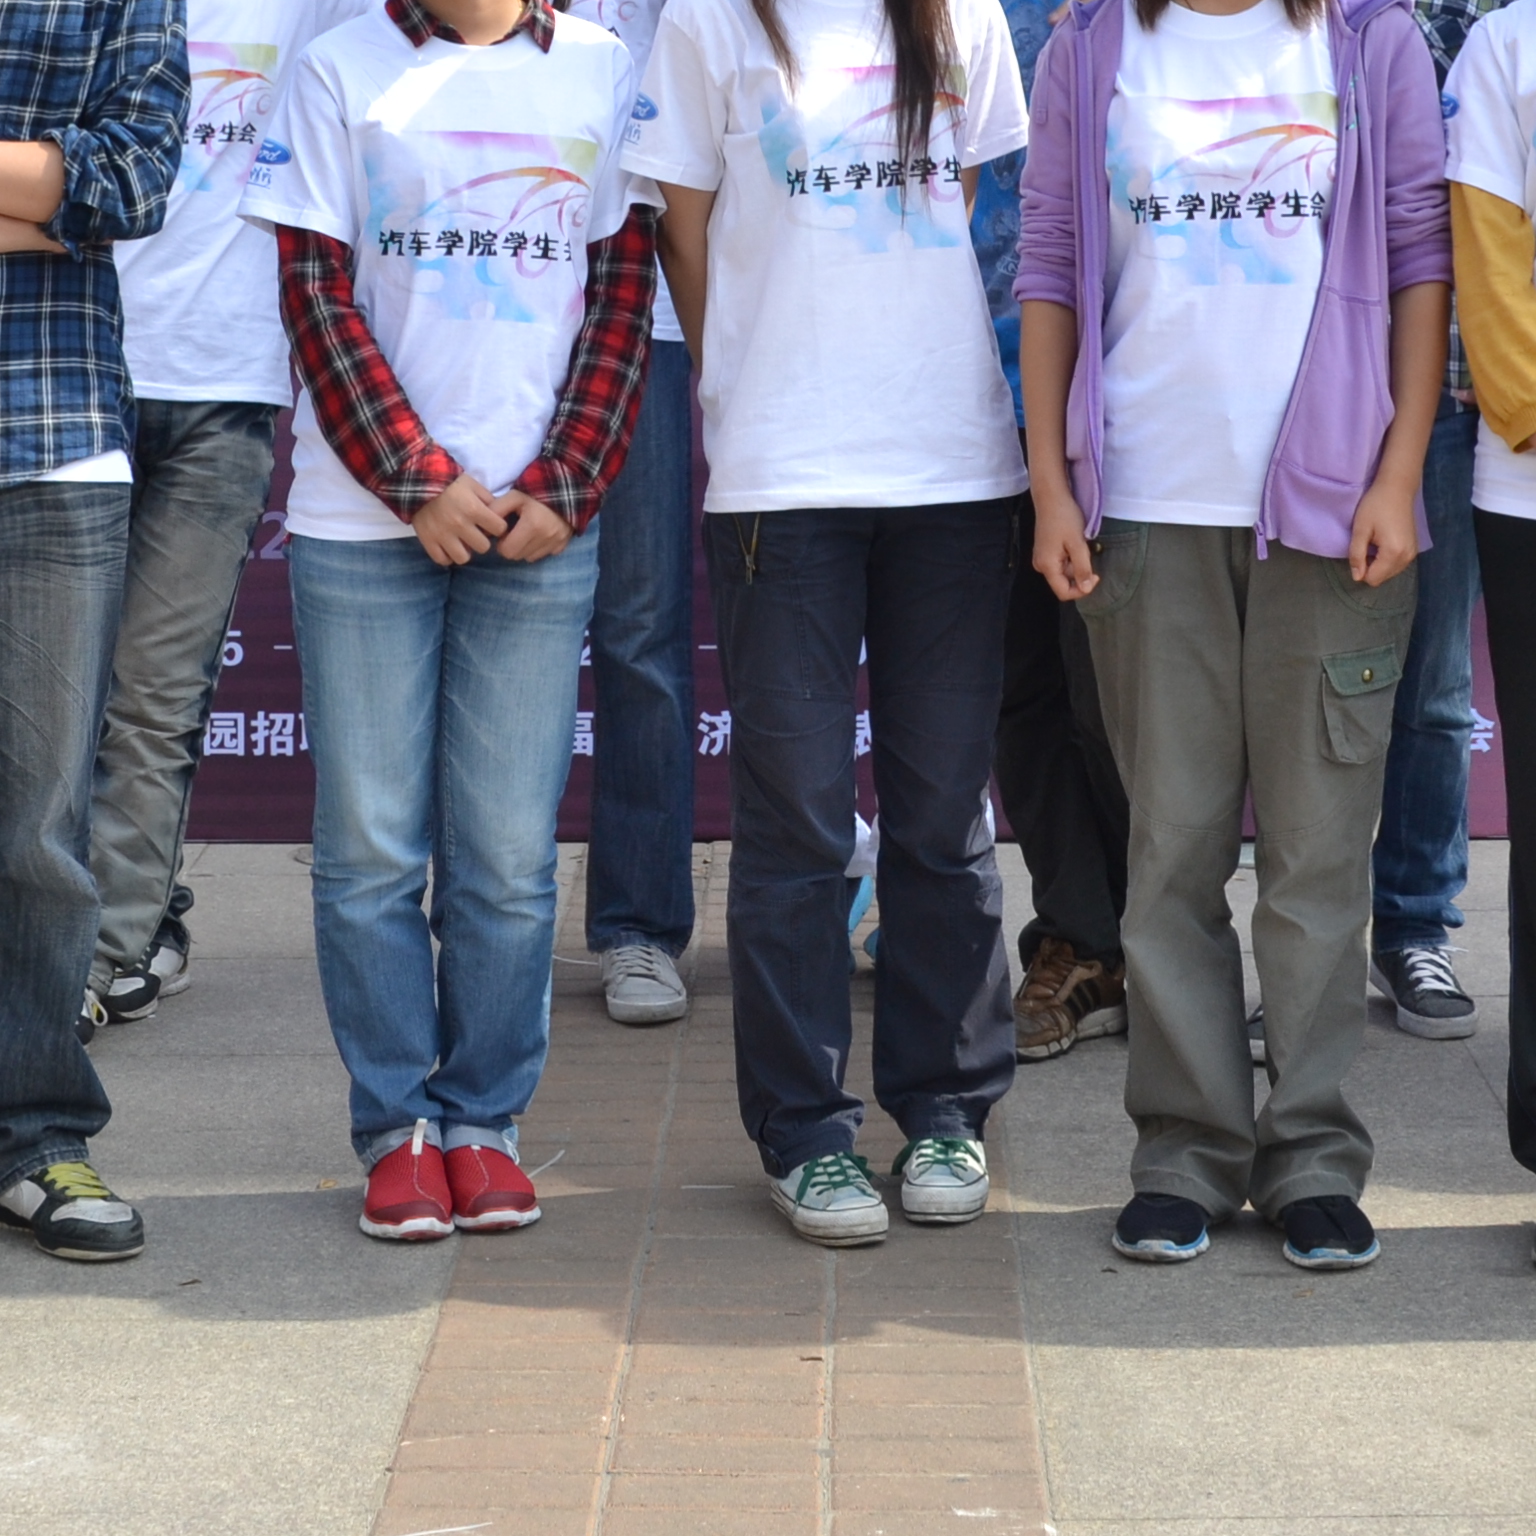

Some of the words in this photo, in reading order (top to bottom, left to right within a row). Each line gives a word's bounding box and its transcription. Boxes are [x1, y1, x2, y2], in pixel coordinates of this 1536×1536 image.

[1128, 189, 1326, 225] 汽车学院学生会
